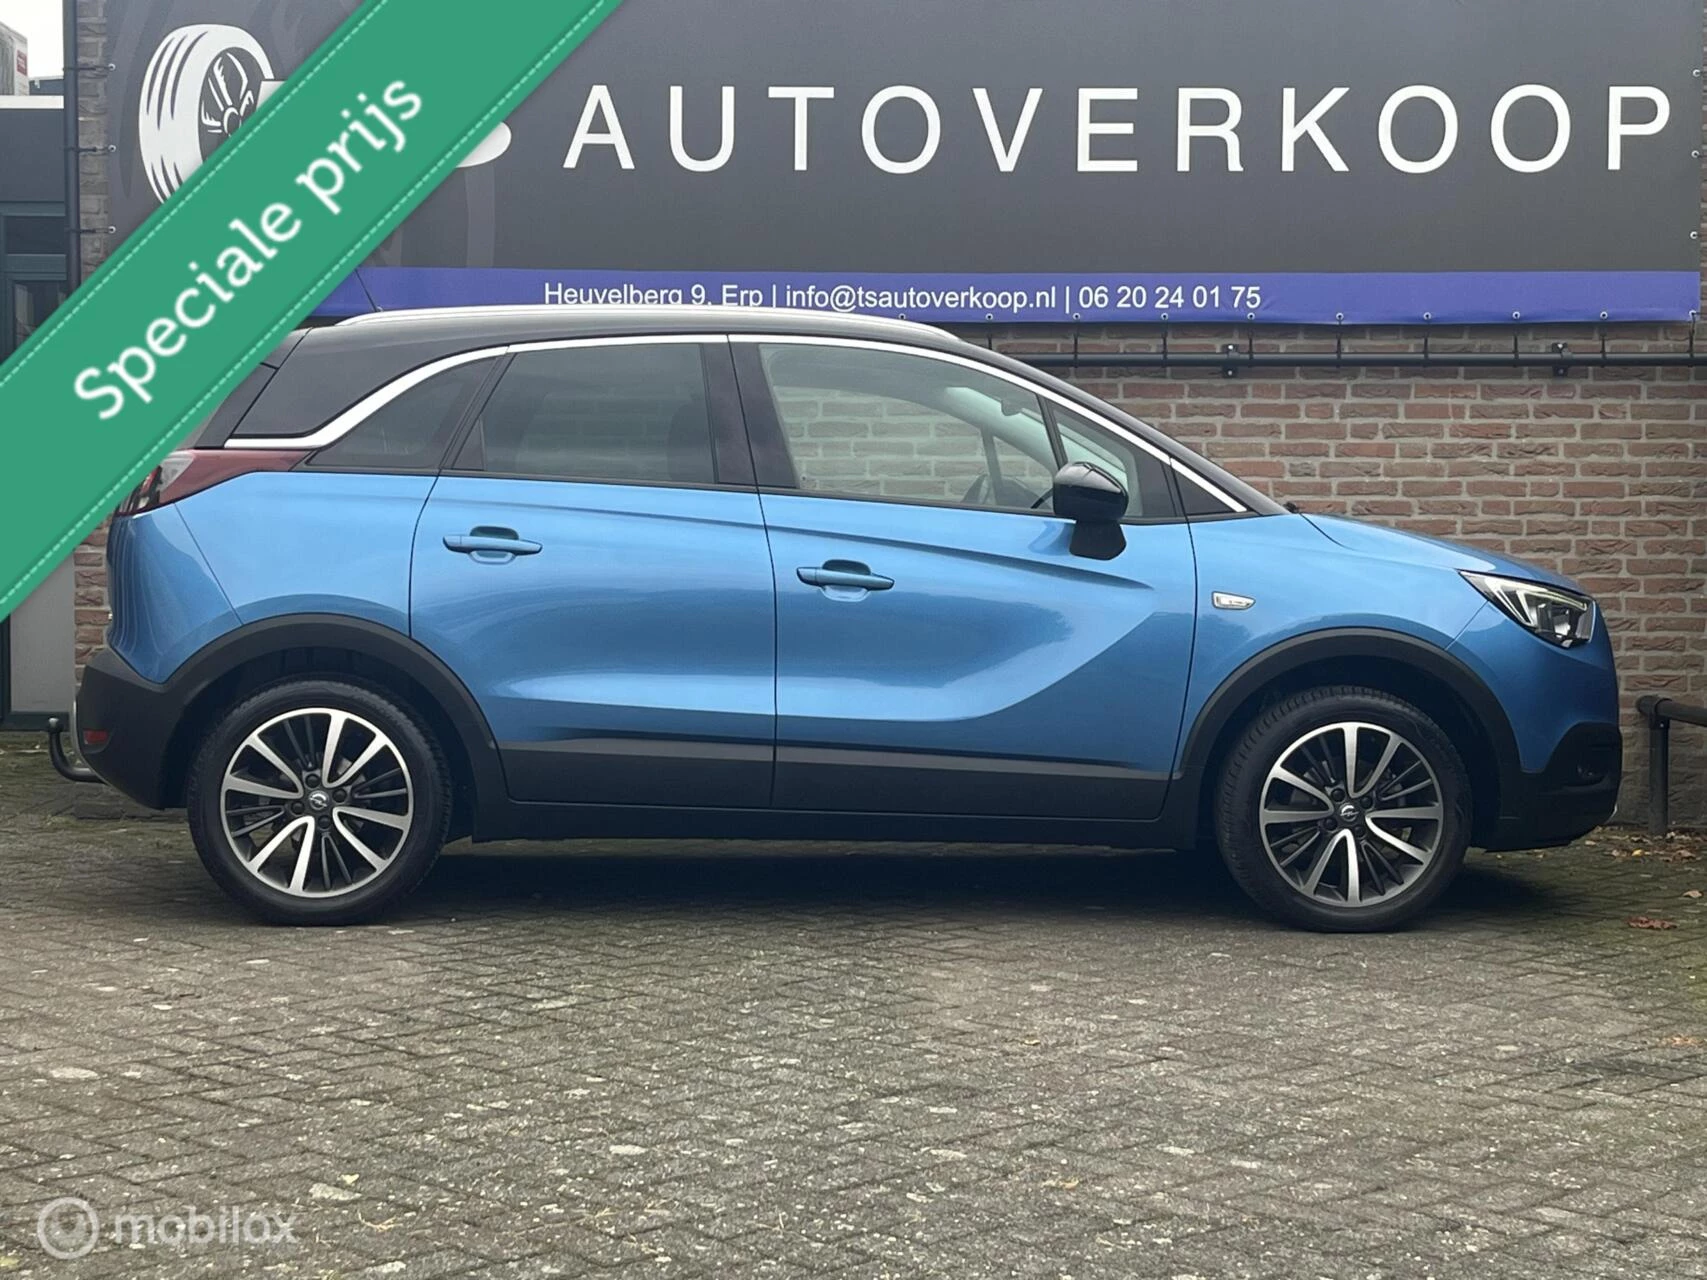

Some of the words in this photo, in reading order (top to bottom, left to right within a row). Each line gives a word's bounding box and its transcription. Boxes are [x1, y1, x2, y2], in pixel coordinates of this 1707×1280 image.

[562, 84, 1671, 174] AUTOVERKOOP
[722, 285, 763, 307] Erp
[786, 285, 1057, 313] info@tsautoverkoop.nl
[1078, 286, 1109, 308] 06
[1116, 286, 1147, 308] 20
[1154, 286, 1184, 308] 24
[1192, 286, 1220, 308] 01
[1231, 286, 1261, 308] 75
